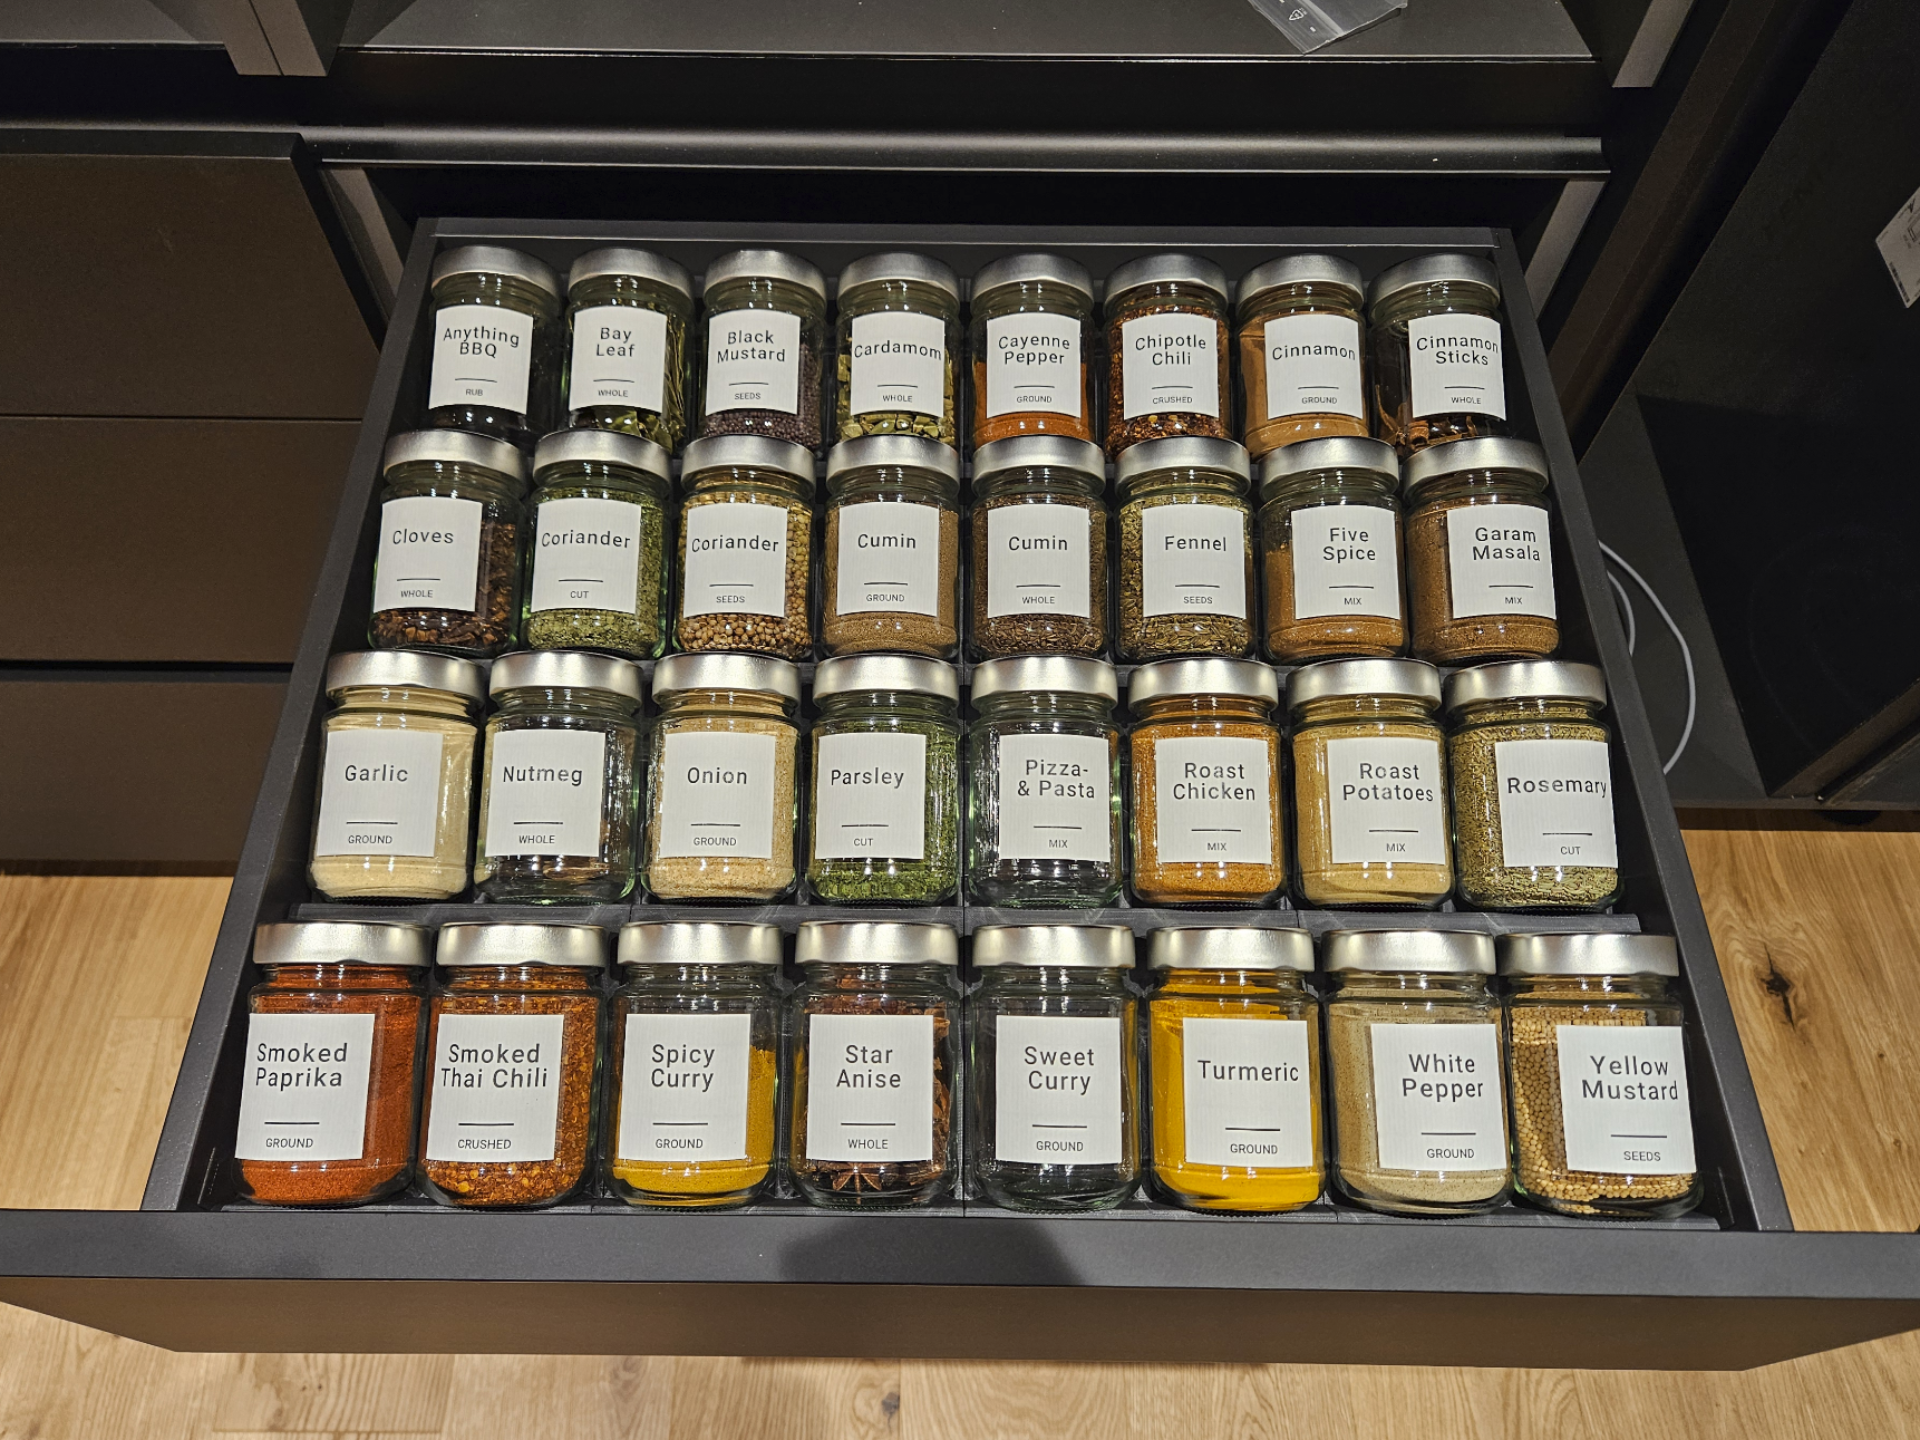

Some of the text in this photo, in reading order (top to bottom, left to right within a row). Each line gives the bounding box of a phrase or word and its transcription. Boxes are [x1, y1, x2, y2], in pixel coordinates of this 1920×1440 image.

[442, 325, 520, 349] Anything
[600, 326, 633, 345] Bay
[727, 329, 774, 346] Black
[998, 335, 1071, 353] Cayenne
[1135, 333, 1207, 353] Chipotle
[459, 341, 498, 359] BBQ
[595, 342, 636, 358] Leaf
[852, 339, 943, 361] Cardamom
[1271, 344, 1356, 361] Cinnamon
[1416, 335, 1499, 354] Cinnamon
[717, 346, 786, 364] Mustard
[1004, 350, 1065, 366] Pepper
[1152, 350, 1191, 366] Chili
[1435, 349, 1489, 366] Sticks
[465, 388, 484, 397] RUB
[597, 389, 629, 398] WHOLE
[734, 392, 761, 401] SEEDS
[882, 394, 913, 403] WHOLE
[1016, 395, 1053, 404] GROUND
[1152, 396, 1193, 405] CRUSHED
[1301, 396, 1338, 405] GROUND
[1451, 396, 1482, 405] WHOLE
[392, 528, 454, 545] Cloves
[541, 530, 631, 549] Coriander
[857, 532, 916, 550] Cumin
[1008, 535, 1068, 551] Cumin
[1329, 527, 1369, 543] Five
[1474, 526, 1537, 543] Garam
[691, 534, 779, 553] Coriander
[1164, 535, 1227, 552] Fennel
[1322, 545, 1376, 564] Spice
[1472, 544, 1541, 562] Masala
[400, 589, 433, 598] WHOLE
[570, 590, 590, 599] CUT
[716, 595, 746, 604] SEEDS
[865, 593, 905, 602] GROUND
[1021, 596, 1055, 604] WHOLE
[1183, 596, 1213, 605] SEEDS
[1344, 597, 1362, 605] MIX
[1504, 596, 1523, 605] MIX
[344, 763, 409, 783] Garlic
[502, 765, 583, 788] Nutmeg
[687, 766, 748, 785] Onion
[1025, 758, 1089, 778] Pizza-
[1184, 762, 1245, 780] Roast
[1359, 762, 1420, 781] Roast
[831, 766, 905, 790] Parsley
[1017, 779, 1095, 799] & Pasta
[1173, 781, 1256, 801] Chicken
[1342, 783, 1434, 803] Potatoes
[1506, 776, 1607, 799] Rosemary
[347, 834, 393, 844] GROUND
[518, 834, 555, 844] WHOLE
[693, 836, 737, 846] GROUND
[853, 837, 874, 847] CUT
[1048, 839, 1068, 849] MIX
[1207, 842, 1227, 851] MIX
[1386, 842, 1406, 852] MIX
[1560, 846, 1581, 855] CUT
[256, 1042, 348, 1063] Smoked
[448, 1042, 541, 1064] Smoked
[651, 1043, 716, 1069] Spicy
[845, 1044, 894, 1064] Star
[1023, 1045, 1095, 1067] Sweet
[1196, 1059, 1299, 1082] Turmeric
[1408, 1053, 1475, 1074] White
[1589, 1055, 1669, 1076] Yellow
[255, 1066, 342, 1092] Paprika
[440, 1066, 548, 1089] Thai Chili
[650, 1067, 715, 1093] Curry
[835, 1068, 901, 1089] Anise
[1028, 1070, 1091, 1096] Curry
[1401, 1077, 1484, 1103] Pepper
[1581, 1079, 1679, 1101] Mustard
[265, 1137, 314, 1149] GROUND
[457, 1138, 512, 1150] CRUSHED
[655, 1138, 704, 1149] GROUND
[847, 1138, 889, 1150] WHOLE
[1036, 1140, 1084, 1152] GROUND
[1229, 1143, 1278, 1155] GROUND
[1426, 1148, 1475, 1159] GROUND
[1623, 1150, 1661, 1162] SEEDS
